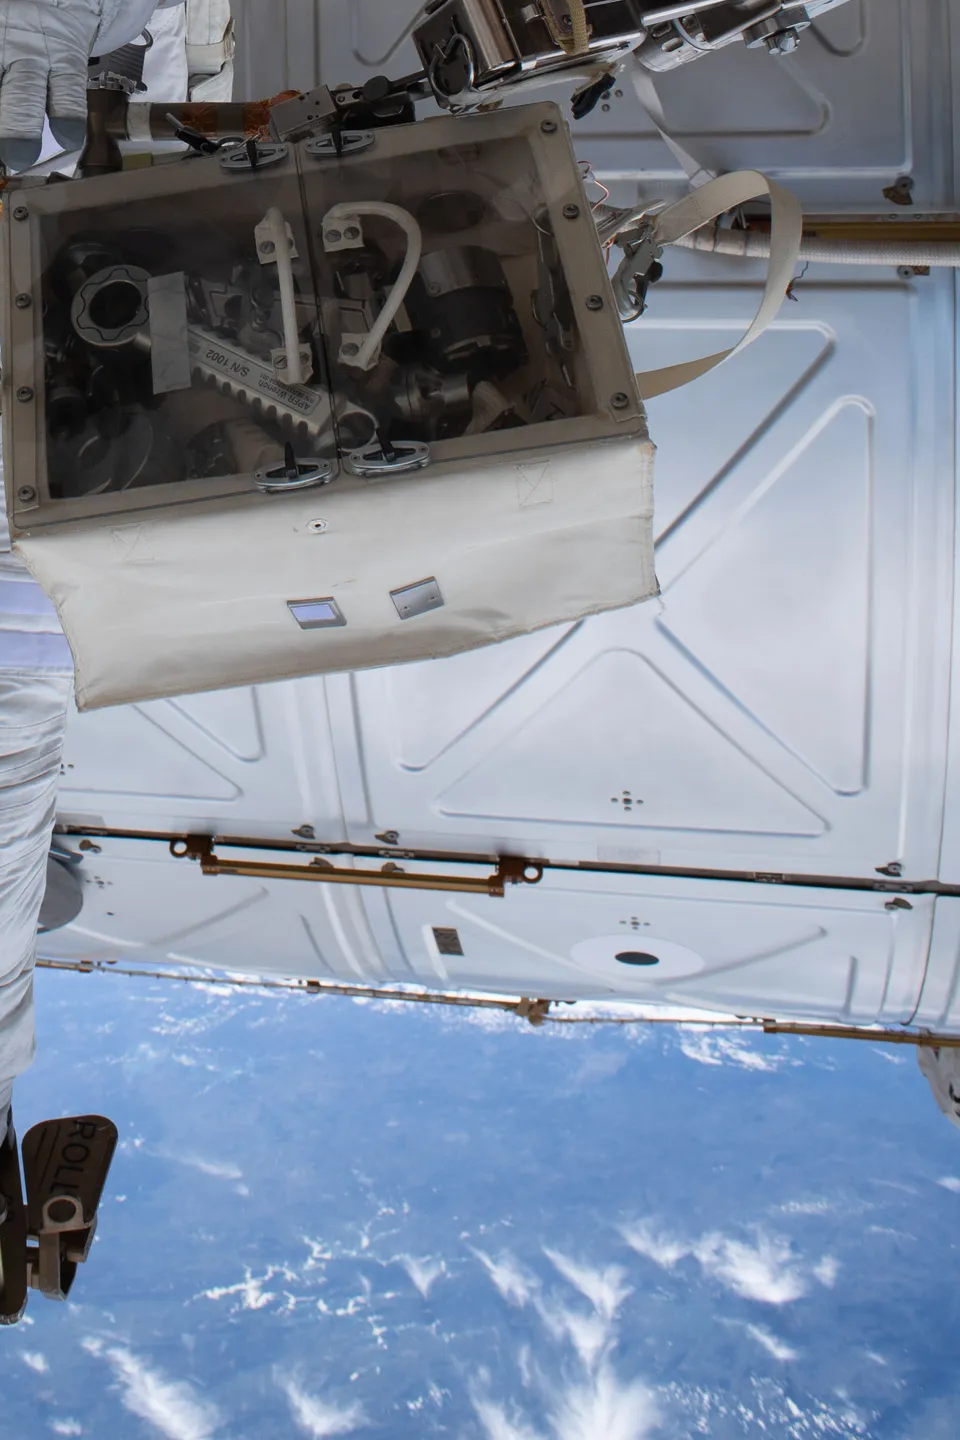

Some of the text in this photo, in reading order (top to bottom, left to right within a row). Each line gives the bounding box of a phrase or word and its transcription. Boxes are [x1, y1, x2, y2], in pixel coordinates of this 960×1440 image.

[205, 349, 250, 377] S/N 1002
[258, 379, 311, 411] APFR Wrench
[51, 1118, 98, 1196] ROLL
